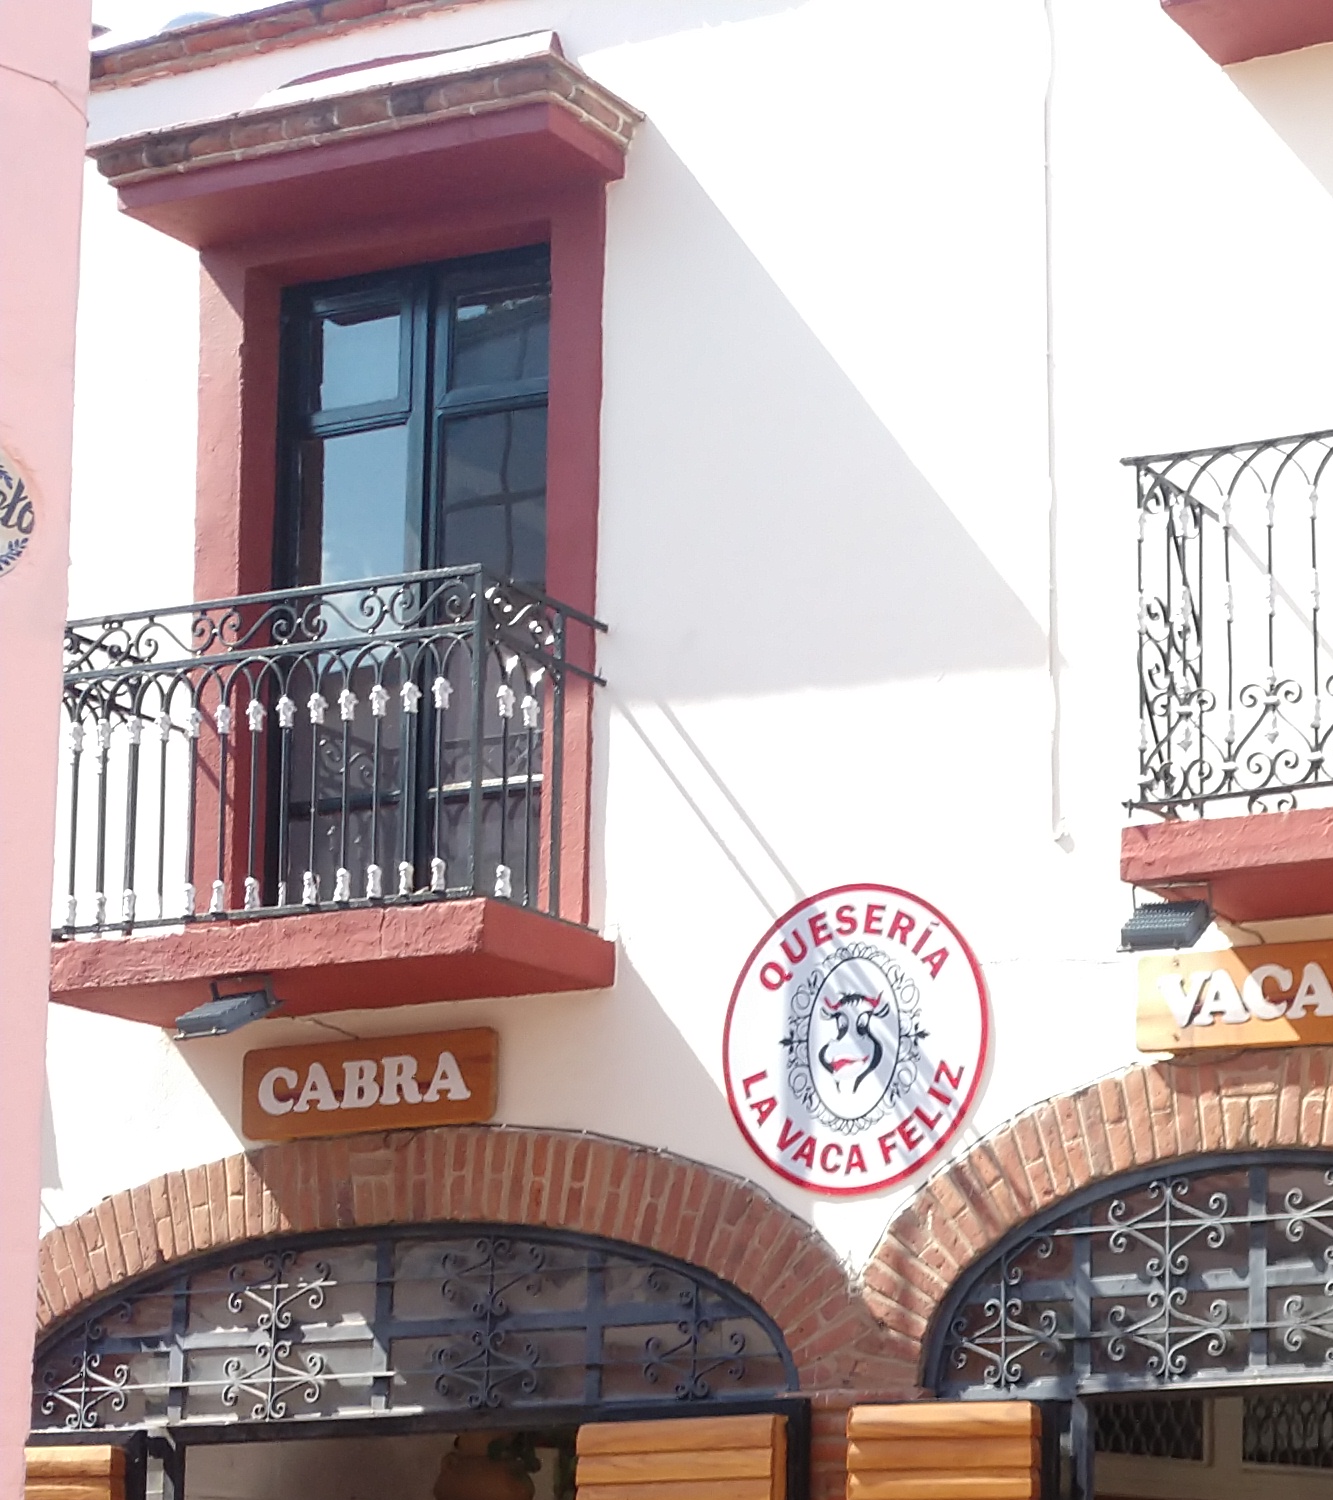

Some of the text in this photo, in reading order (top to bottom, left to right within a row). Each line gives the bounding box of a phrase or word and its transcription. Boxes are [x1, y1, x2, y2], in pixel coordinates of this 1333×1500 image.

[760, 902, 950, 991] QUESERÍA
[258, 1051, 472, 1116] CABRA
[742, 1059, 965, 1175] LA VACA FELIZ
